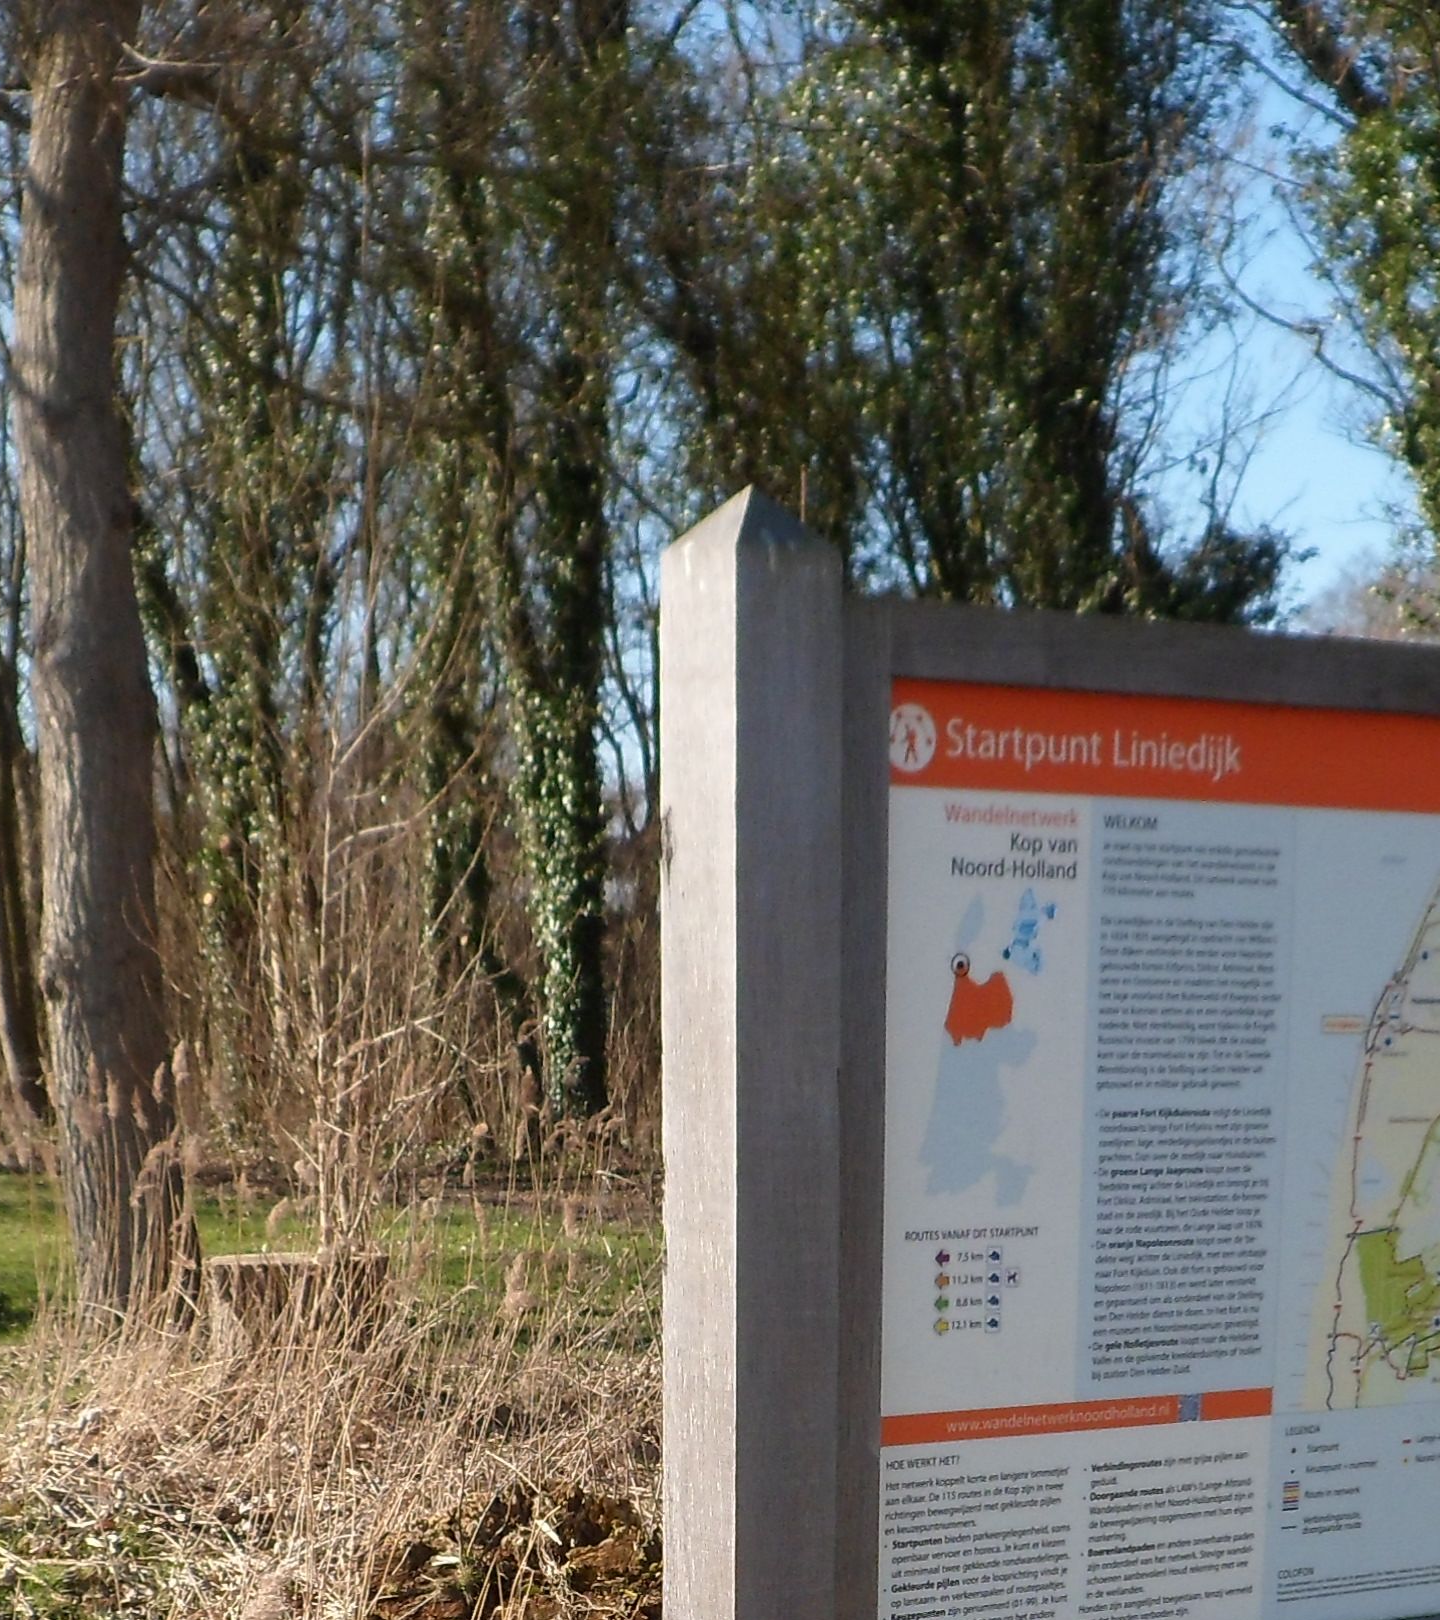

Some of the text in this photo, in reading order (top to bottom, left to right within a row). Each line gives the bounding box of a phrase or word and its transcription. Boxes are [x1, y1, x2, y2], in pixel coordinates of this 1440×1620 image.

[947, 718, 1242, 783] Startpunt Liniedijk
[944, 804, 1078, 827] Wandelnetwerk
[1103, 815, 1158, 831] WELKOM
[1010, 833, 1077, 855] Kop van
[951, 857, 1077, 880] Noord-Holland
[905, 1226, 1039, 1241] ROUTES VANAF DIT STARTPUNT
[886, 1460, 904, 1470] HOE
[907, 1457, 937, 1468] WERKT
[892, 1538, 942, 1549] Startpunten
[891, 1581, 935, 1593] Gekleurde
[891, 1610, 946, 1620] Keuzepunten
